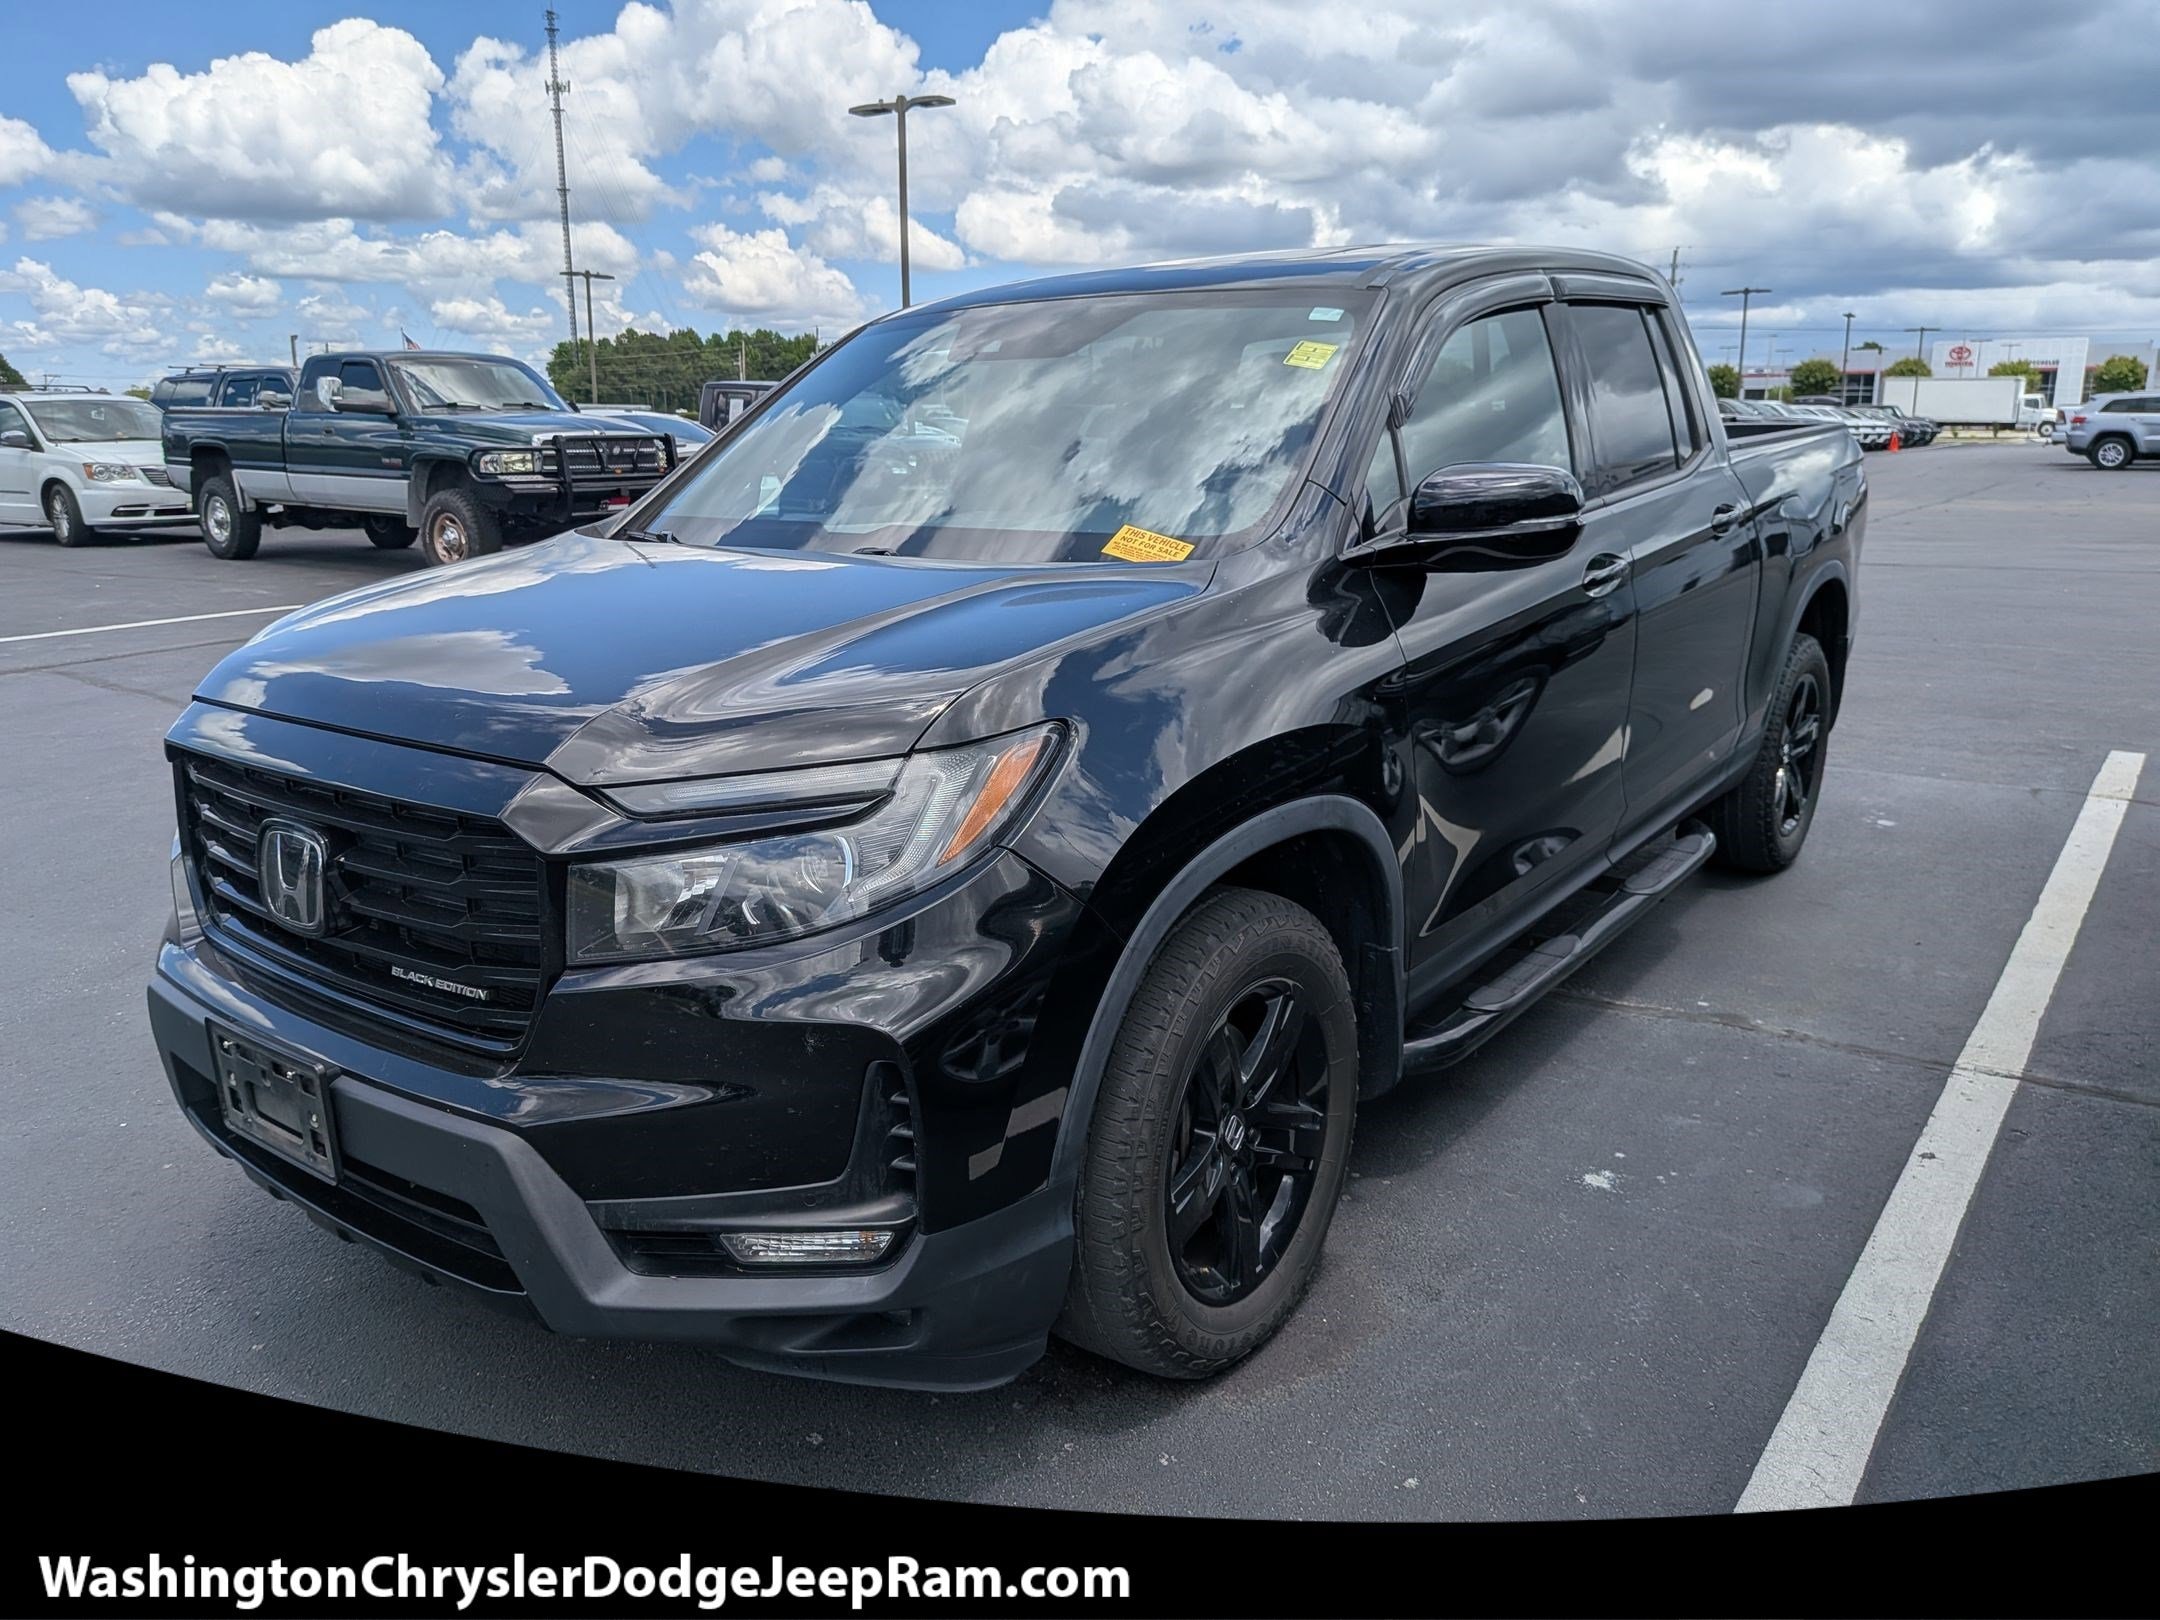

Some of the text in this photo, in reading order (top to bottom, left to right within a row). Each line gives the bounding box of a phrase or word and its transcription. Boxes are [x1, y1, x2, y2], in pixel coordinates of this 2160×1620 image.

[1119, 535, 1139, 545] NOT
[1138, 541, 1156, 550] FOR
[1157, 546, 1181, 558] SALE
[1124, 527, 1147, 540] THIS
[1147, 534, 1189, 553] VEHICLE
[391, 965, 489, 1001] BLACK EDITION
